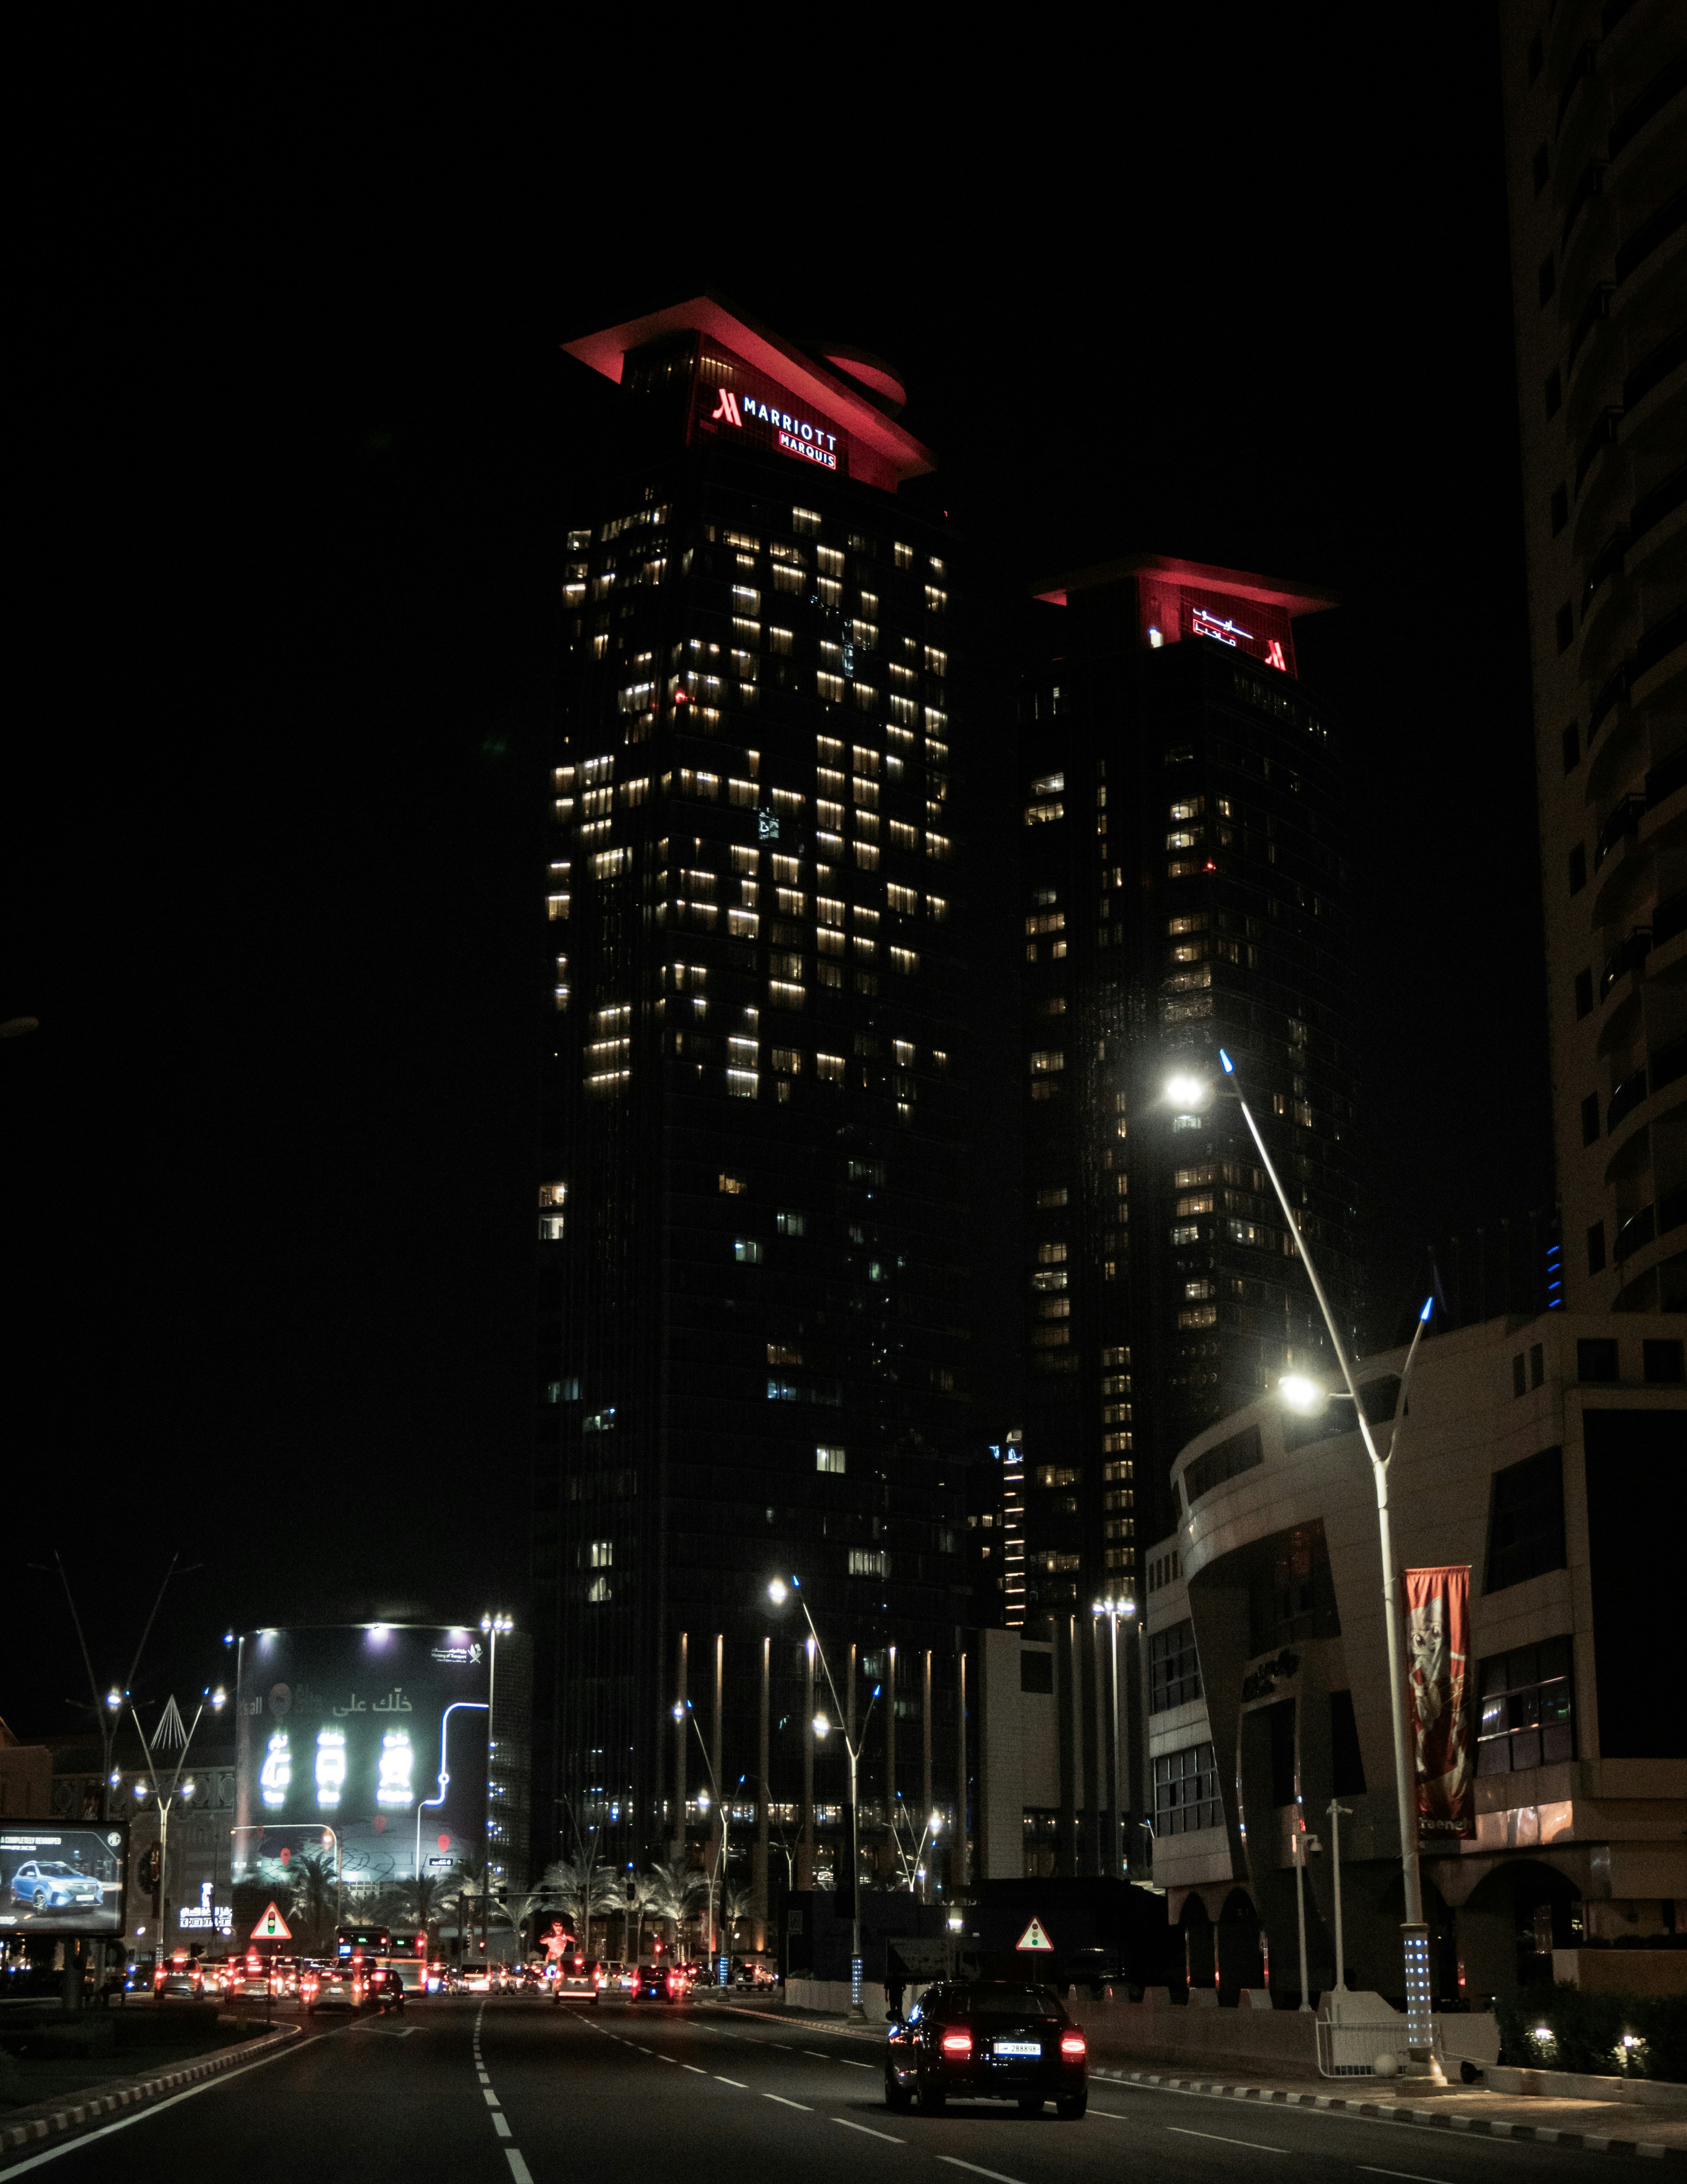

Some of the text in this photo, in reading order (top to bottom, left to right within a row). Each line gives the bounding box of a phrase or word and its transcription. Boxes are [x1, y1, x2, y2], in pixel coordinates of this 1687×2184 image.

[744, 396, 836, 451] MARRIOTT
[781, 434, 835, 467] MARQUIS
[333, 1688, 412, 1717] خلّك على
